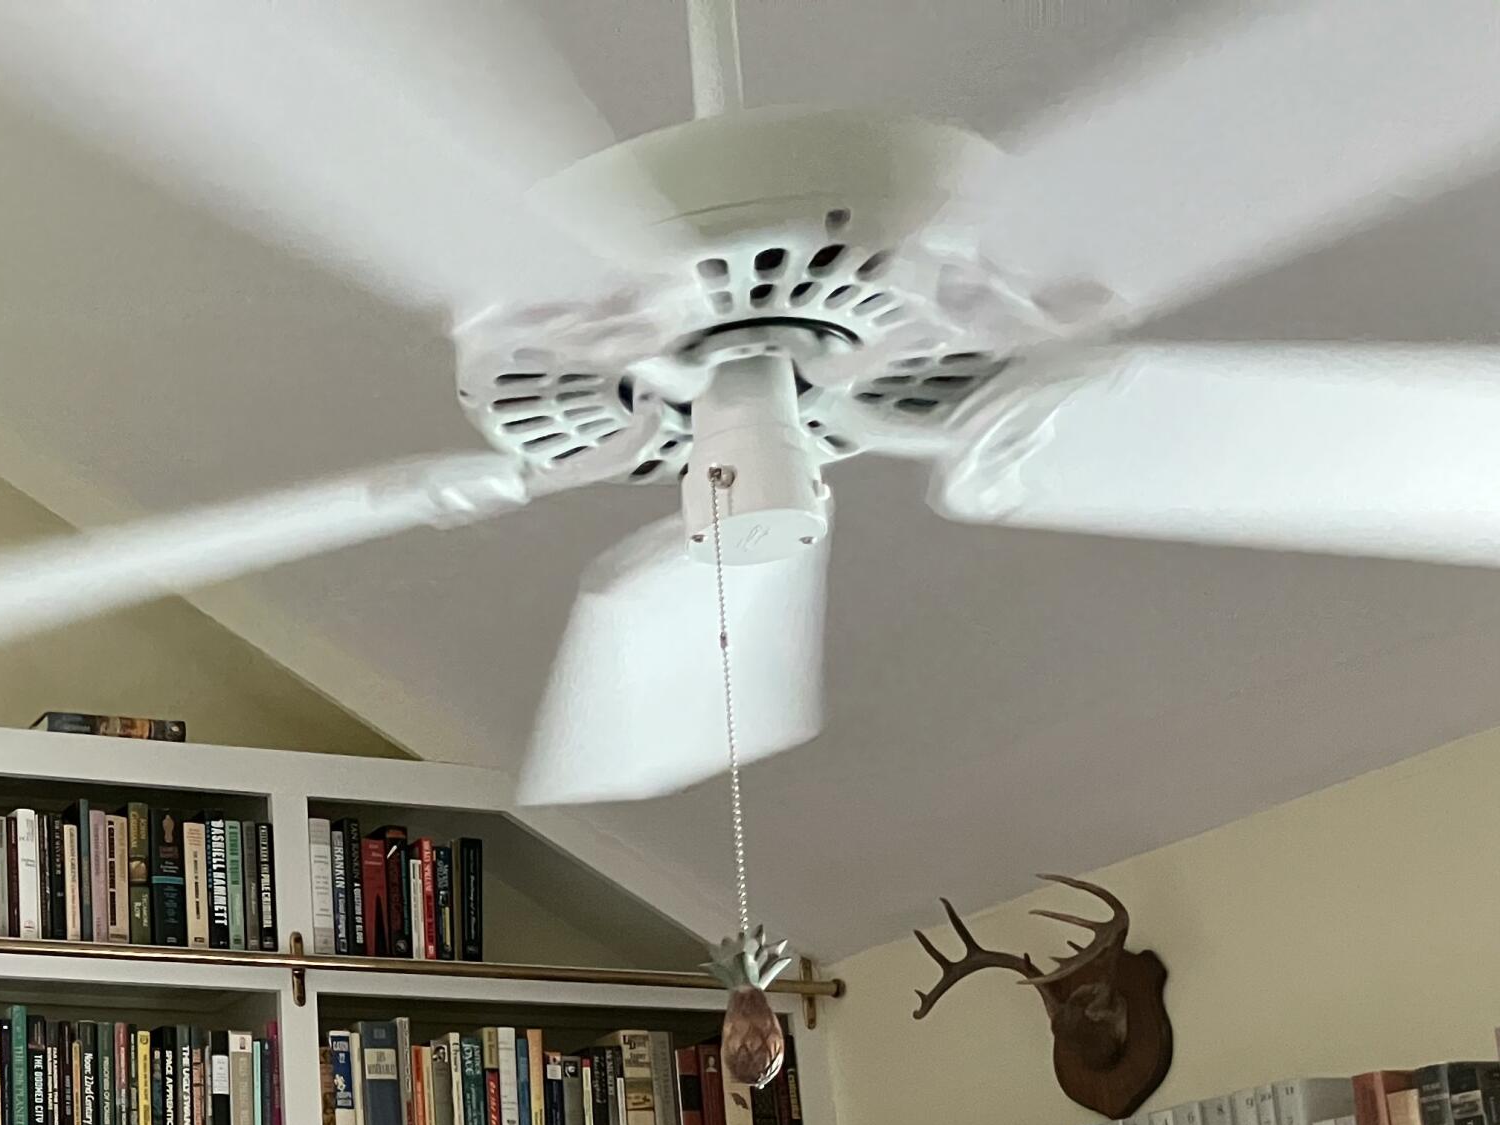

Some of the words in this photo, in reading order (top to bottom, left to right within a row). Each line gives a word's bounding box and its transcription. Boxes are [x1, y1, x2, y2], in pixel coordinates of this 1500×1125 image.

[211, 821, 226, 869] DASHIELL
[336, 846, 345, 888] RANKIN
[134, 901, 142, 919] ROW
[213, 872, 227, 926] HAMMETT
[34, 1055, 42, 1070] THE
[165, 1050, 175, 1074] SPACE
[182, 1046, 190, 1066] THE
[462, 1041, 475, 1076] JOYCE
[34, 1072, 43, 1104] DOOMED
[182, 1068, 191, 1094] UGLY
[35, 1105, 44, 1123] CITY
